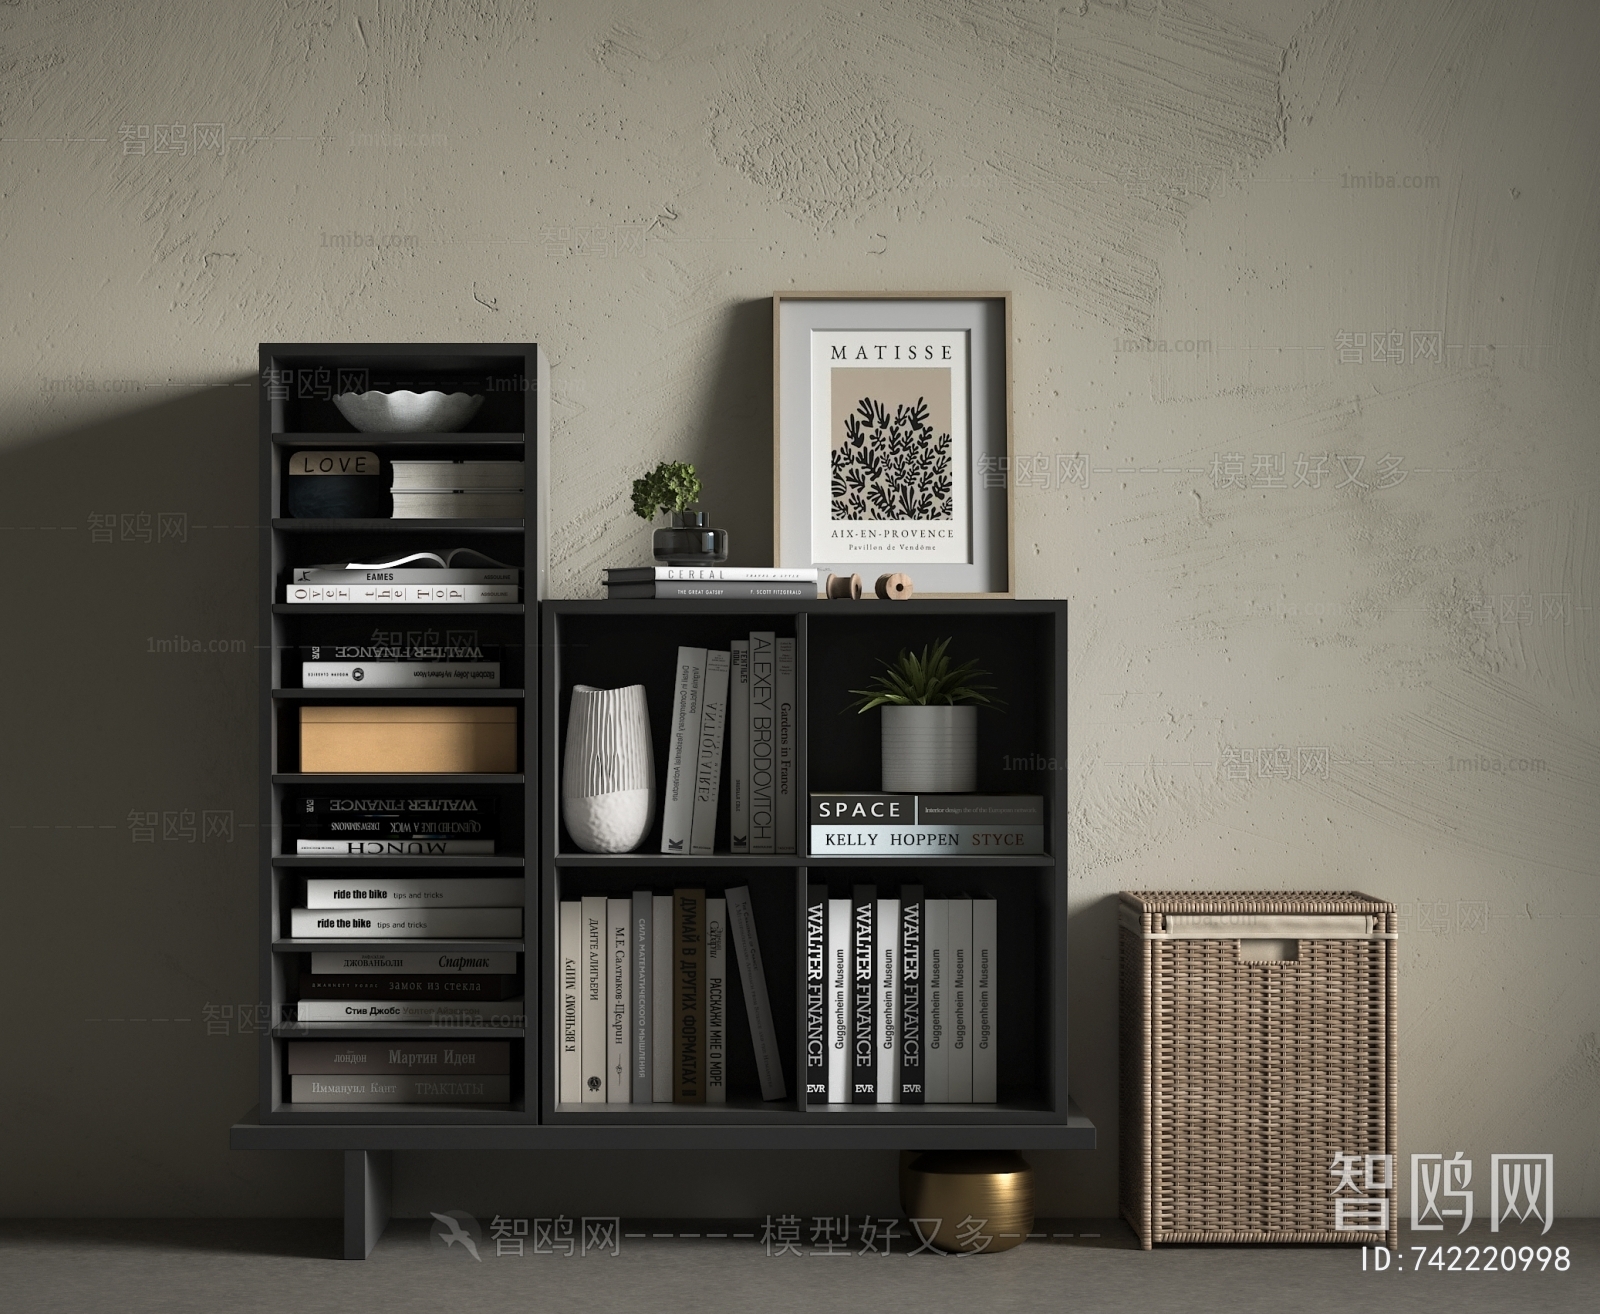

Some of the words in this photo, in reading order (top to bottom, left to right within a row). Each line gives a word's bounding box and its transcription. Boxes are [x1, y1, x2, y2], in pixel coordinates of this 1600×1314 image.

[830, 344, 953, 360] MATISSE
[303, 456, 368, 473] LOVE
[830, 528, 954, 539] AIX-EN-PROVENCE
[848, 543, 884, 551] Pavillon
[886, 543, 896, 551] de
[899, 543, 937, 551] Vendôme
[366, 572, 394, 582] EAMES
[667, 568, 725, 580] CEREAL
[294, 588, 348, 600] Over
[365, 589, 404, 599] the
[417, 588, 463, 600] Top
[705, 588, 724, 596] GATSBY
[311, 646, 320, 660] EVR
[335, 646, 408, 658] FINANCE
[413, 646, 484, 658] WALTER
[453, 670, 470, 679] Jolley
[740, 649, 748, 684] TEXTILES
[753, 637, 772, 711] ALEXEY
[780, 702, 791, 745] Gardens
[780, 746, 791, 758] in
[753, 717, 772, 839] BRODOVITCH
[780, 759, 791, 795] France
[306, 799, 315, 813] EVR
[330, 799, 404, 811] FINANCE
[407, 799, 478, 811] WALTER
[818, 801, 901, 818] SPACE
[945, 806, 963, 814] design
[331, 821, 361, 831] SIMMONS
[361, 822, 380, 831] DREW
[390, 821, 412, 832] WICK
[413, 822, 420, 832] A
[420, 821, 437, 832] LIKE
[438, 819, 482, 833] QUENCHED
[346, 842, 447, 855] MUNCH
[825, 833, 878, 846] KELLY
[890, 833, 960, 846] HOPPEN
[971, 833, 1025, 846] STYCE
[333, 889, 351, 900] ride
[352, 889, 367, 900] the
[369, 889, 388, 900] bike
[393, 891, 407, 900] tips
[408, 891, 422, 899] and
[423, 891, 444, 899] tricks
[317, 918, 335, 929] ride
[336, 918, 351, 929] the
[352, 918, 372, 929] bike
[377, 921, 391, 930] tips
[392, 921, 405, 929] and
[407, 921, 428, 929] tricks
[680, 896, 700, 943] ДУМАЙ
[589, 918, 599, 950] ДАНТЕ
[615, 926, 626, 948] М.Е.
[638, 918, 646, 942] СИЛА
[808, 902, 823, 981] WALTER
[856, 902, 871, 981] WALTER
[904, 902, 919, 981] WALTER
[682, 948, 697, 956] В
[343, 959, 404, 968] ДЖОВАНЬОЛИ
[438, 955, 490, 972] Спартак
[834, 949, 844, 988] Museum
[883, 949, 892, 988] Museum
[930, 949, 939, 988] Museum
[954, 949, 963, 988] Museum
[979, 949, 988, 988] Museum
[565, 957, 576, 990] МИРУ
[589, 951, 599, 1001] АЛИГЬЕРИ
[388, 980, 423, 991] замок
[427, 981, 440, 990] из
[444, 981, 482, 992] стекла
[638, 943, 646, 1027] МАТЕМАТИЧЕСКОГО
[680, 960, 697, 1011] ДРУГИХ
[612, 949, 625, 1045] Салтыков-Щедрин
[709, 978, 722, 1028] РАССКАЖИ
[345, 1006, 368, 1015] Стив
[369, 1006, 401, 1017] Джобс
[565, 993, 576, 1044] ВЕЧНОМУ
[834, 990, 846, 1050] Guggenheim
[883, 990, 895, 1050] Guggenheim
[930, 990, 942, 1050] Guggenheim
[954, 990, 966, 1050] Guggenheim
[979, 990, 991, 1050] Guggenheim
[808, 983, 823, 1067] FINANCE
[856, 983, 871, 1067] FINANCE
[904, 983, 919, 1067] FINANCE
[565, 1045, 576, 1053] К
[709, 1030, 722, 1050] МНЕ
[388, 1049, 438, 1067] Мартин
[443, 1049, 477, 1067] Иден
[638, 1028, 646, 1078] МЫШЛЕНИЯ
[681, 1015, 697, 1085] ФОРМАТАХ
[709, 1062, 722, 1087] МОРЕ
[311, 1082, 366, 1096] Иммануил
[369, 1082, 397, 1094] Кант
[414, 1082, 485, 1096] ТРАКТАТЫ
[855, 1084, 874, 1093] EVR
[902, 1084, 921, 1093] EVR
